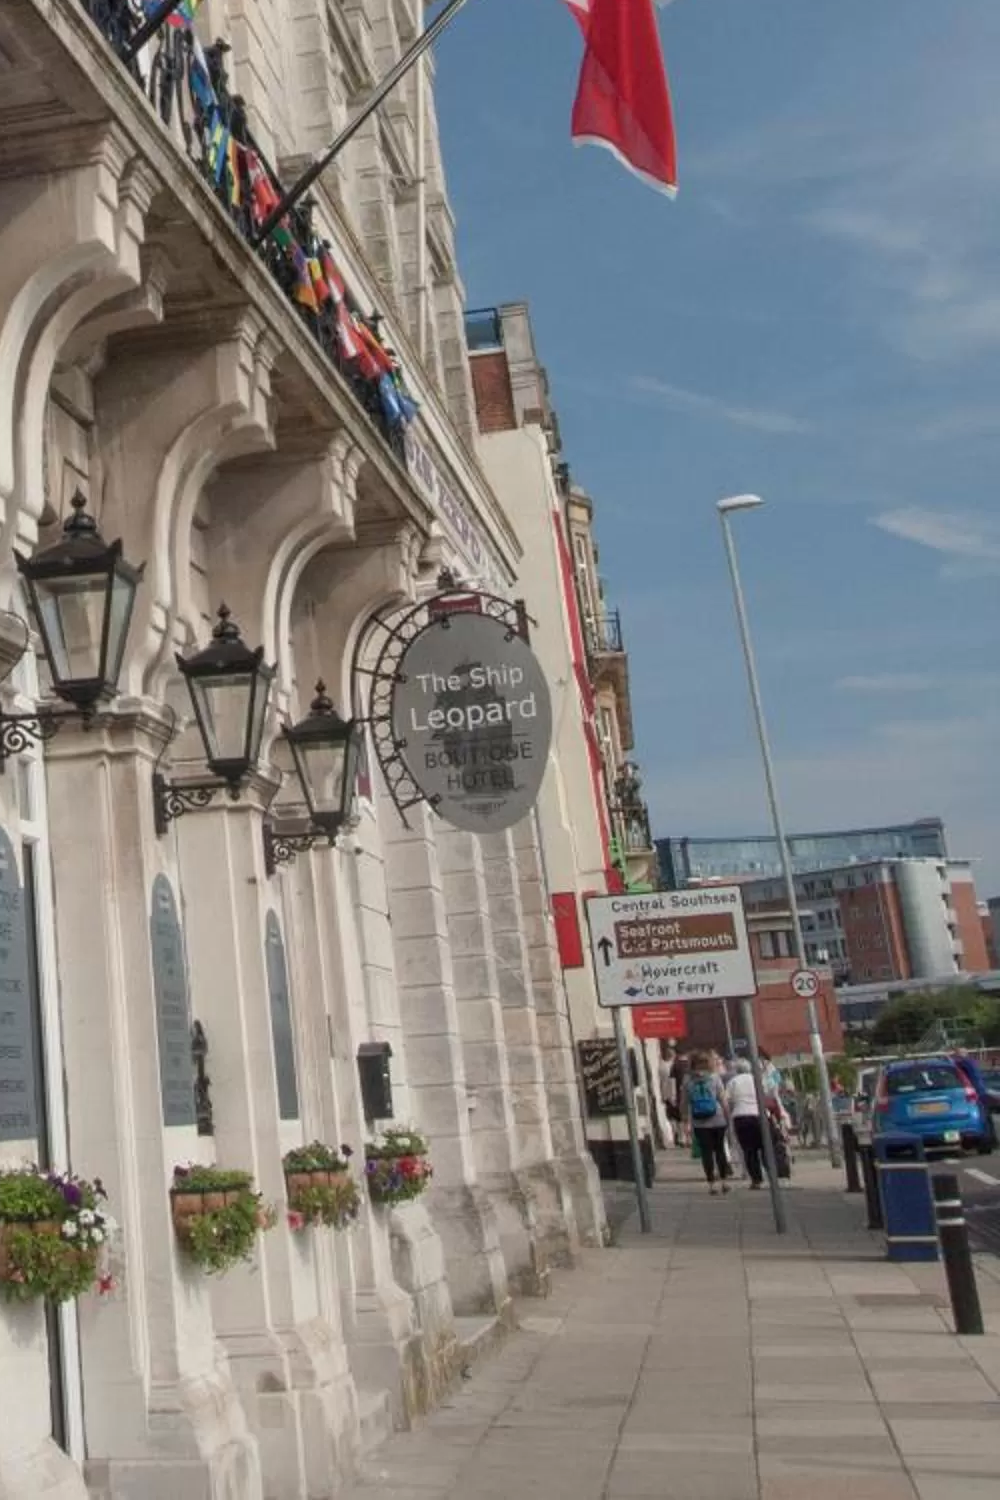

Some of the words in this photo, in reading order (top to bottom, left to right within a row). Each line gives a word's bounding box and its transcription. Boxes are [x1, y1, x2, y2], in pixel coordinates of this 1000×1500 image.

[415, 671, 461, 693] The
[468, 662, 524, 689] Ship
[409, 690, 537, 732] Leopard
[424, 740, 533, 770] BOUTIQUE
[611, 897, 666, 914] Central
[671, 892, 738, 909] Southsea
[619, 921, 681, 939] Seafront
[651, 931, 734, 951] Portsmouth
[641, 960, 720, 980] Hovercraft
[645, 983, 670, 997] Car
[677, 980, 715, 996] Ferry
[796, 976, 815, 991] 20
